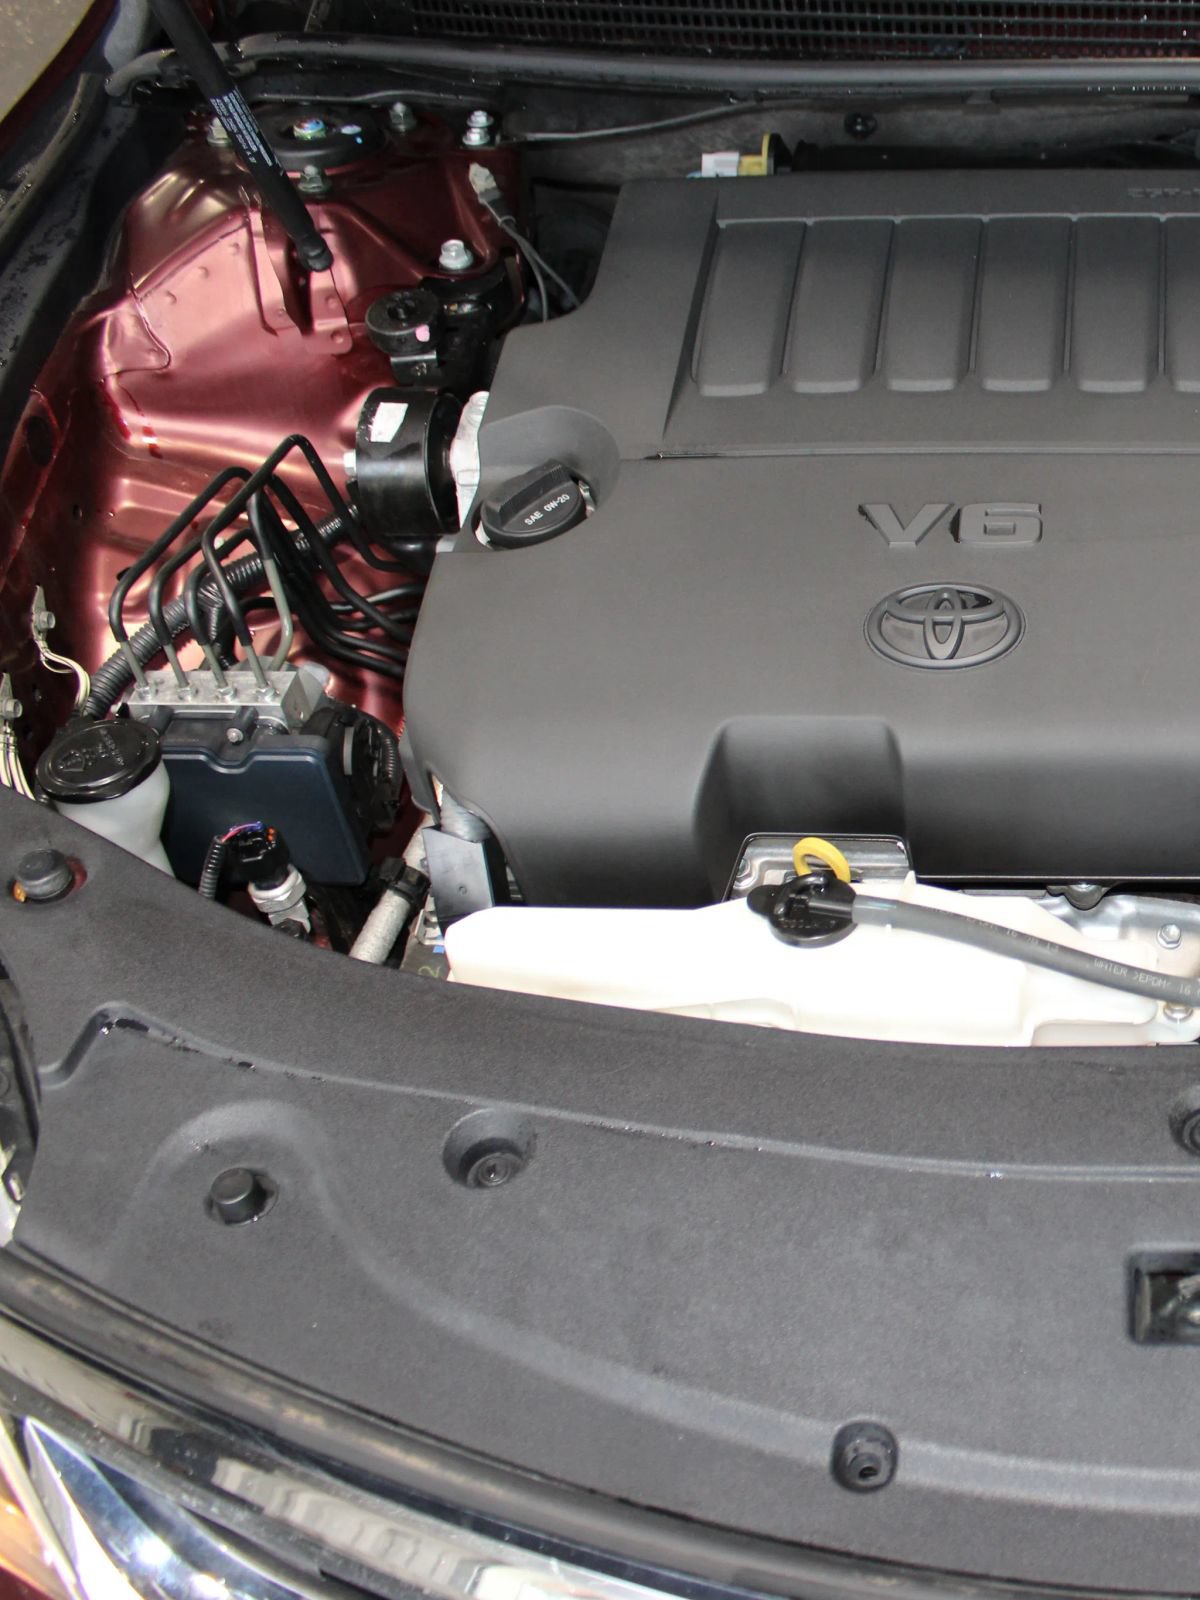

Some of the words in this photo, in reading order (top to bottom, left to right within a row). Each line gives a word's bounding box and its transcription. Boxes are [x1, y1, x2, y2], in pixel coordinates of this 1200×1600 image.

[524, 511, 543, 526] SAE
[543, 493, 571, 512] 0W-20
[858, 502, 1043, 549] V6
